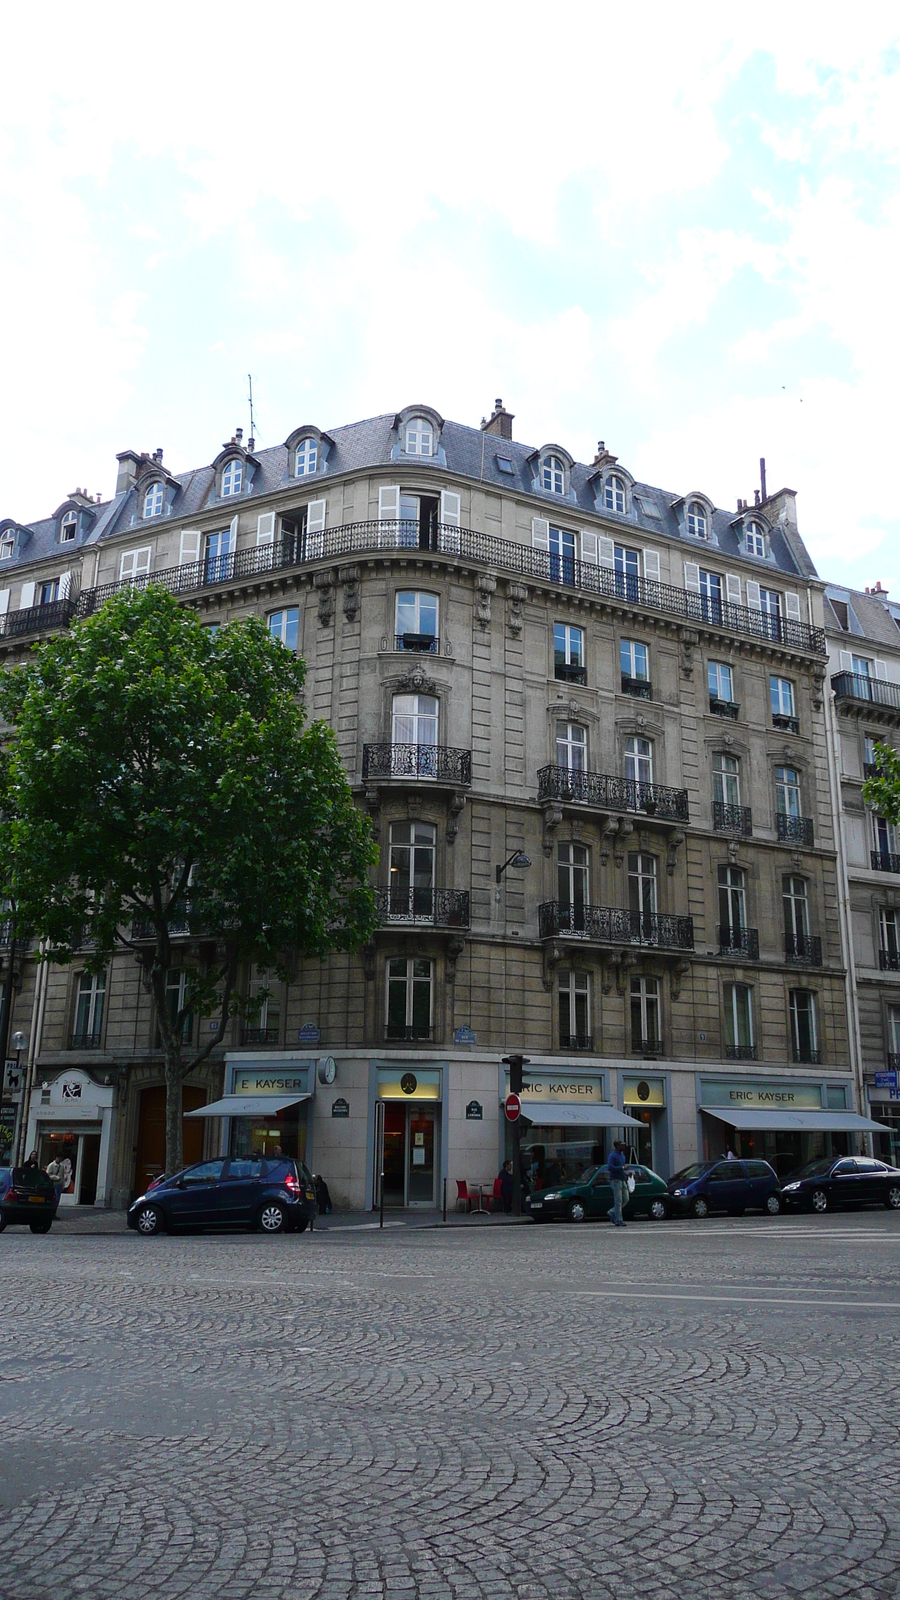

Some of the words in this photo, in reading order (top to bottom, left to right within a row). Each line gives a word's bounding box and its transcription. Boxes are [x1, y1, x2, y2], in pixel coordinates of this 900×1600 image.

[241, 1079, 249, 1089] E
[255, 1079, 302, 1089] KAYSER
[549, 1083, 593, 1094] KAYSER
[729, 1091, 753, 1100] ERIC
[758, 1091, 795, 1102] KAYSER
